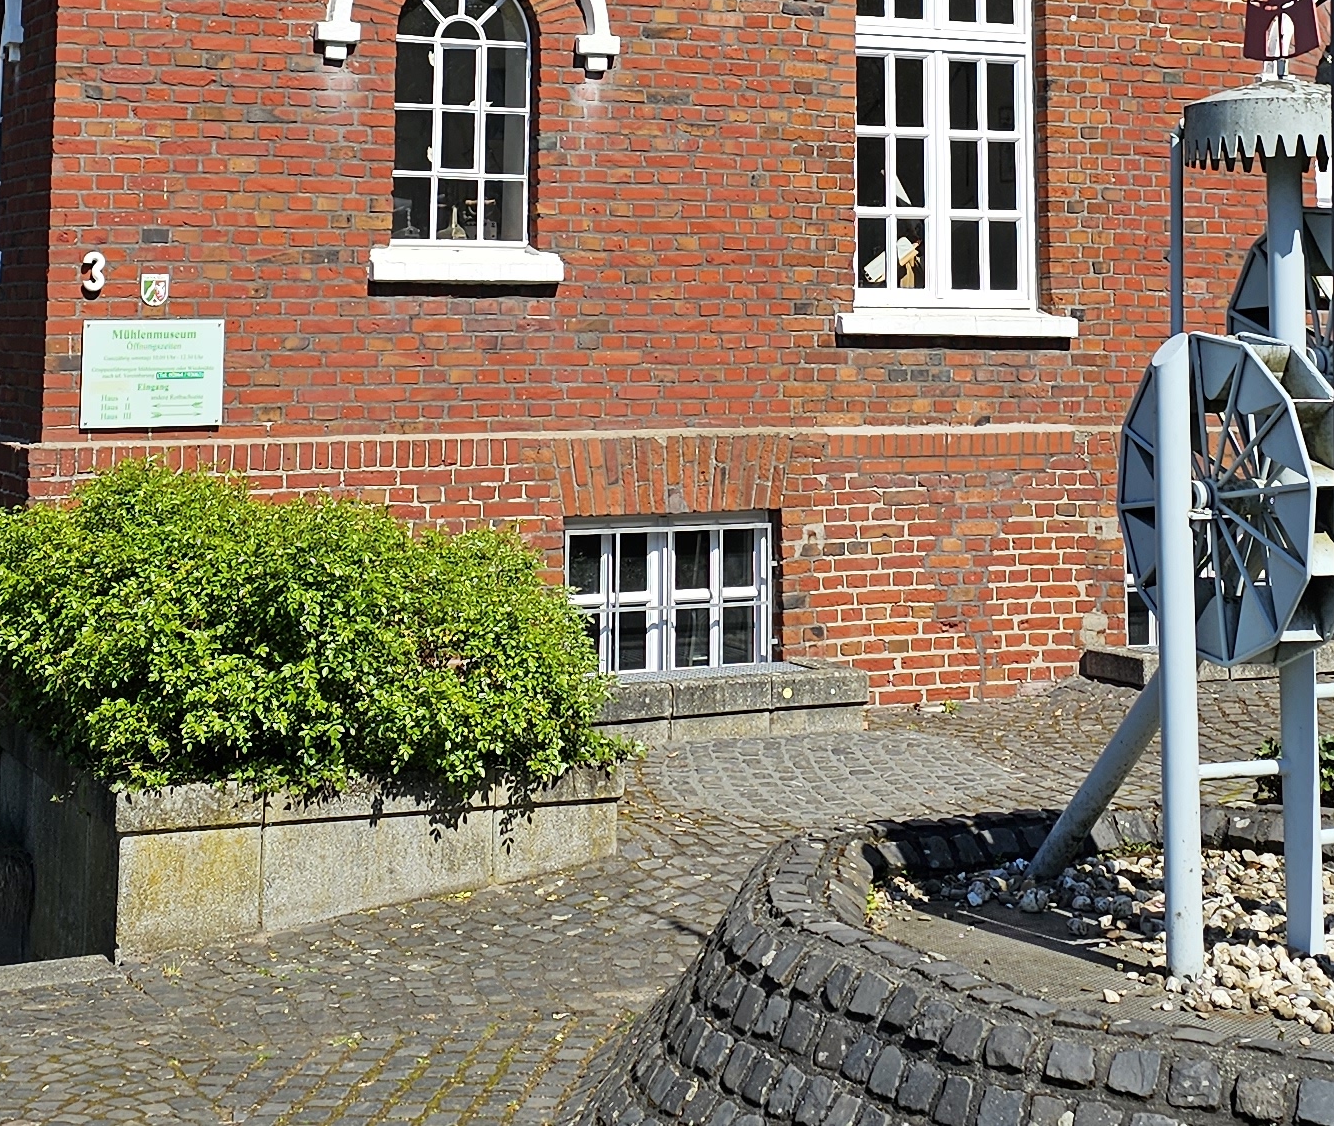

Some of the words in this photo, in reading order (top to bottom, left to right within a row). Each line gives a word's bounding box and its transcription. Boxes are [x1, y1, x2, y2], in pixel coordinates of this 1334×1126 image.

[82, 251, 106, 292] 3
[112, 329, 197, 340] Mühlenmuseum
[126, 342, 182, 351] Öffnungszeiten
[137, 383, 169, 392] Eingang
[101, 403, 118, 411] Haus
[124, 403, 131, 411] II
[123, 412, 132, 420] III
